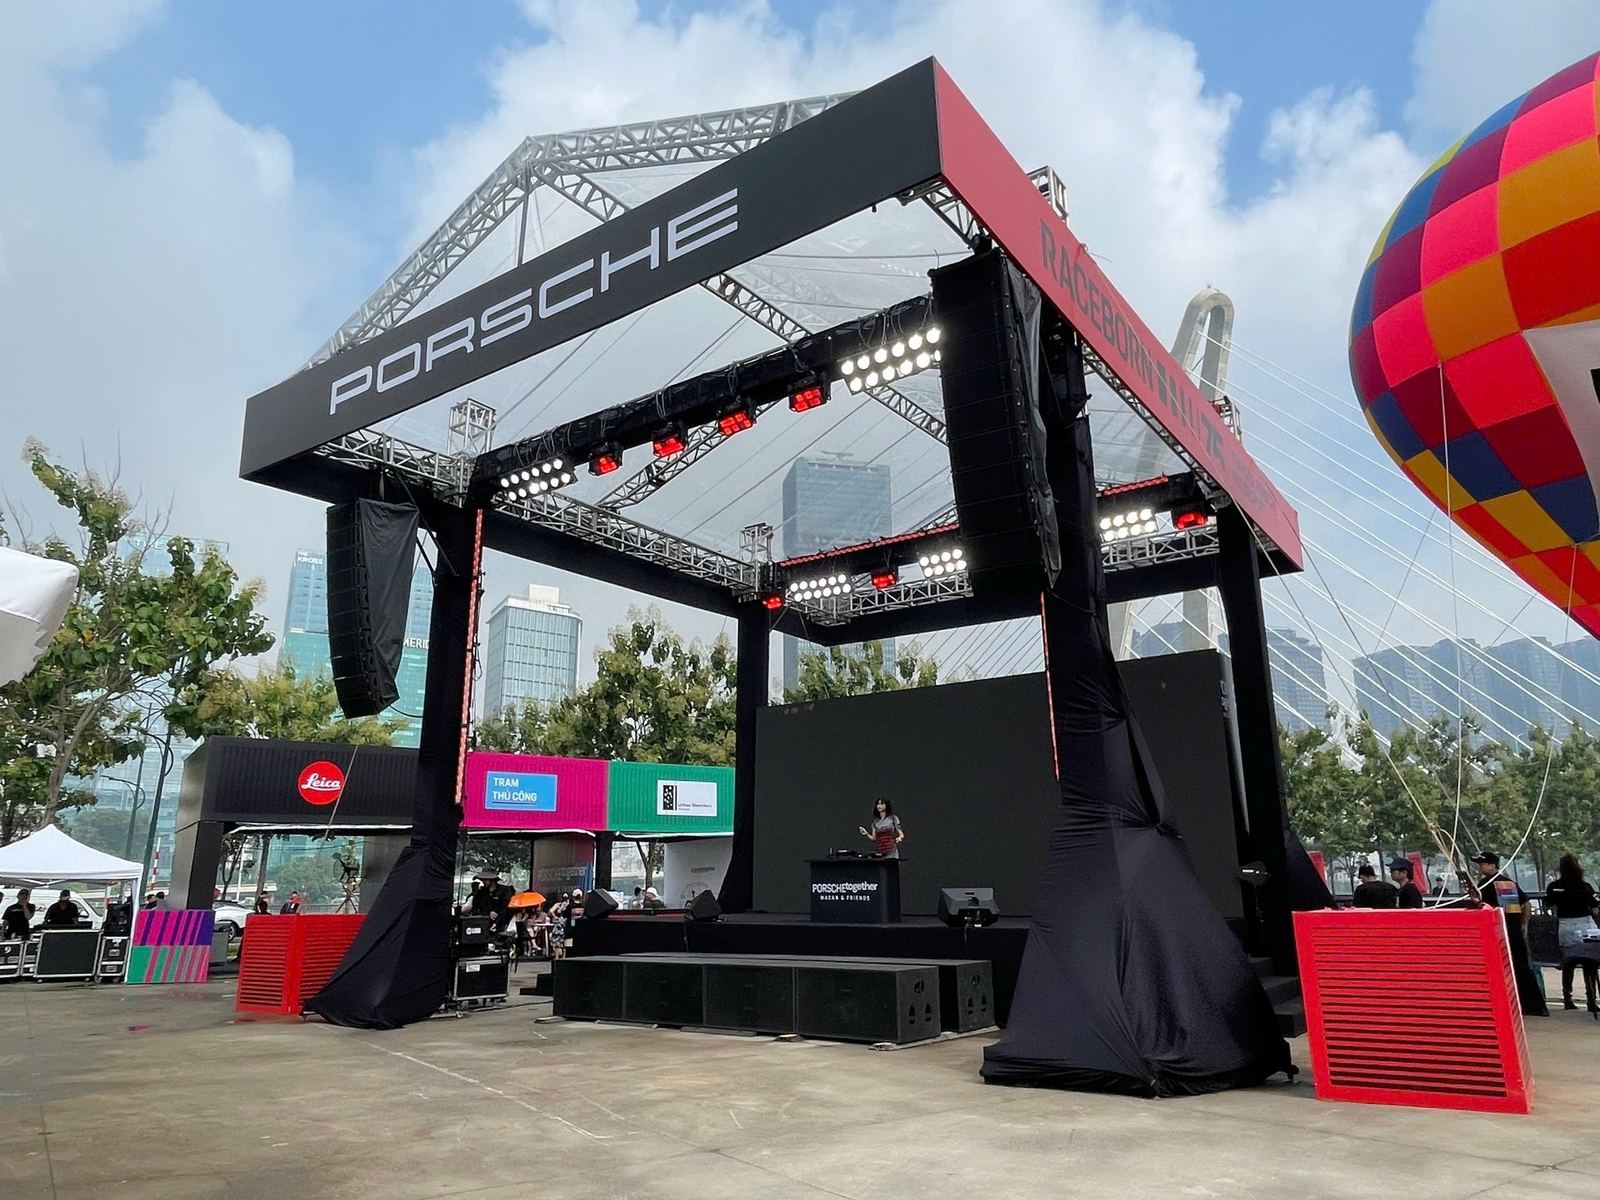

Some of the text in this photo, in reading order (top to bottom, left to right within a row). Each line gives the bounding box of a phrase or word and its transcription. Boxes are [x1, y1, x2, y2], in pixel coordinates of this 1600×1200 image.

[329, 188, 739, 415] PORSCHE
[1040, 218, 1154, 392] RACEBORN
[301, 773, 341, 791] Leica
[512, 790, 538, 802] CÔNG
